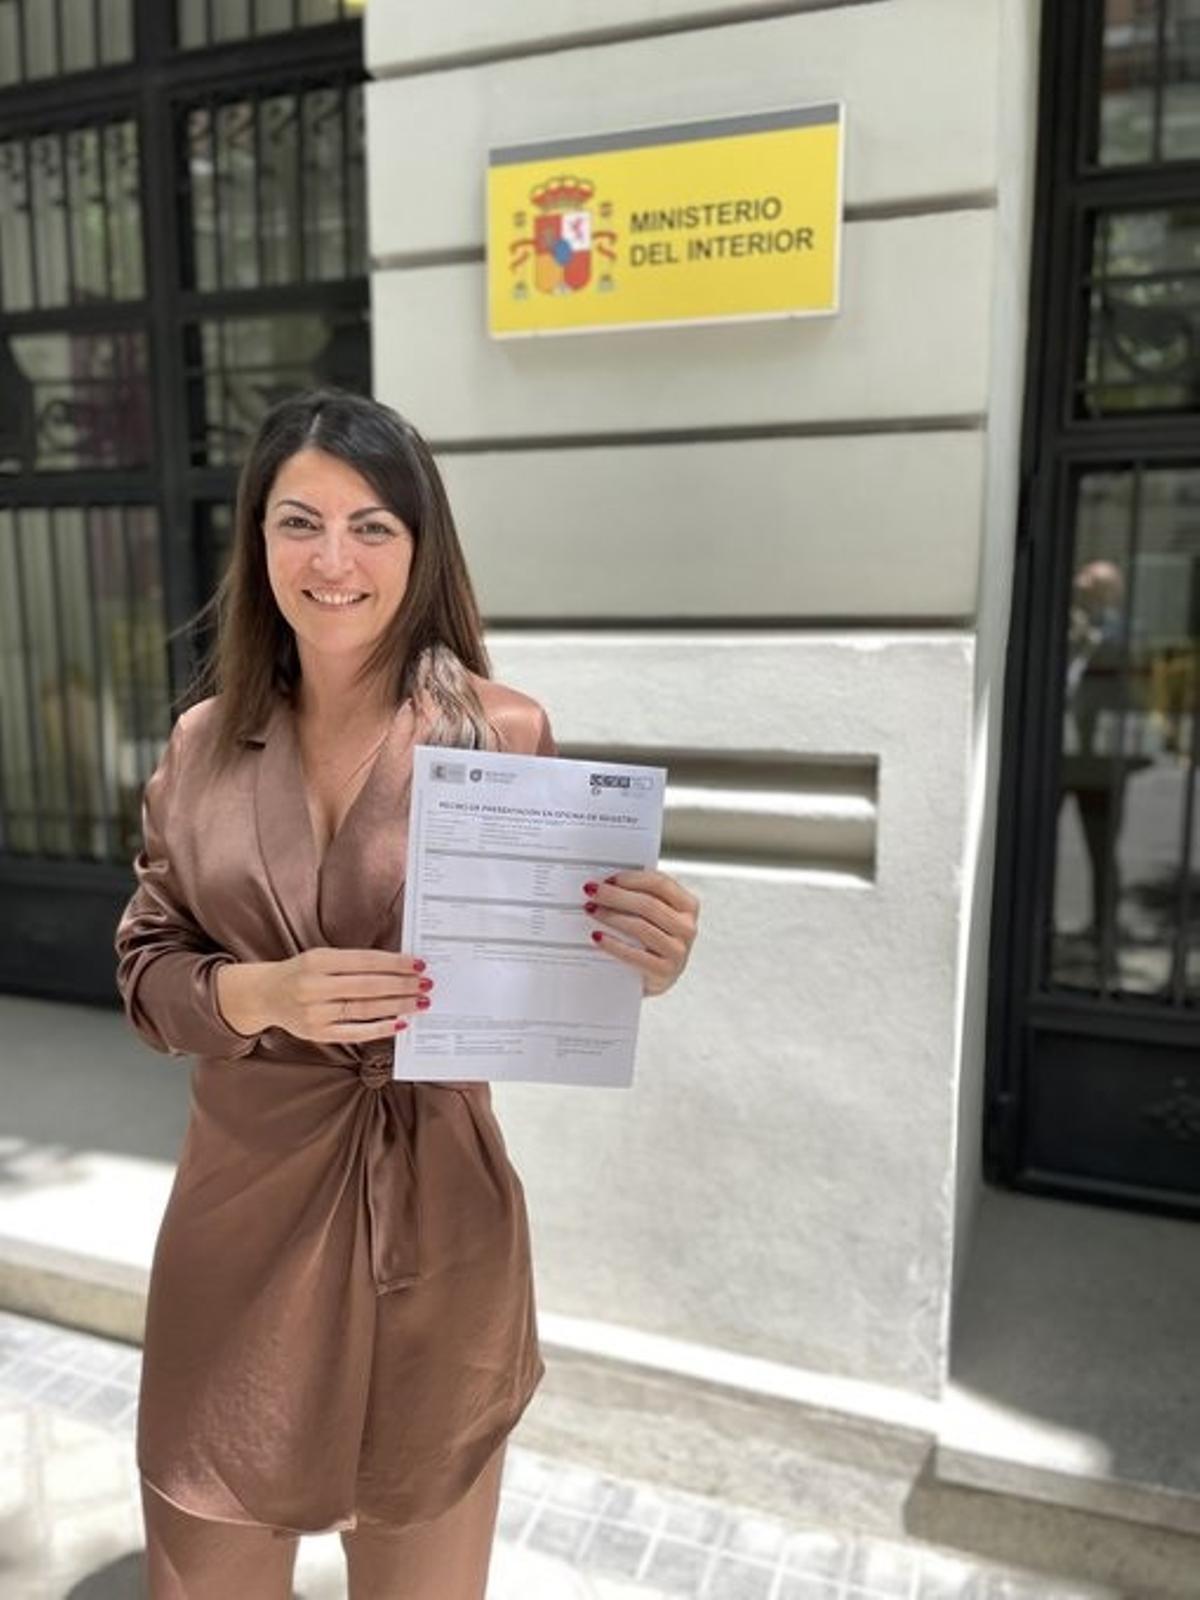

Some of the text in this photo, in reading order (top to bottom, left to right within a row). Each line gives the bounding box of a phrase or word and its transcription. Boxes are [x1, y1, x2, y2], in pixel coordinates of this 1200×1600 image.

[630, 196, 782, 234] MINISTERIO
[630, 226, 814, 268] DEL INTERIOR
